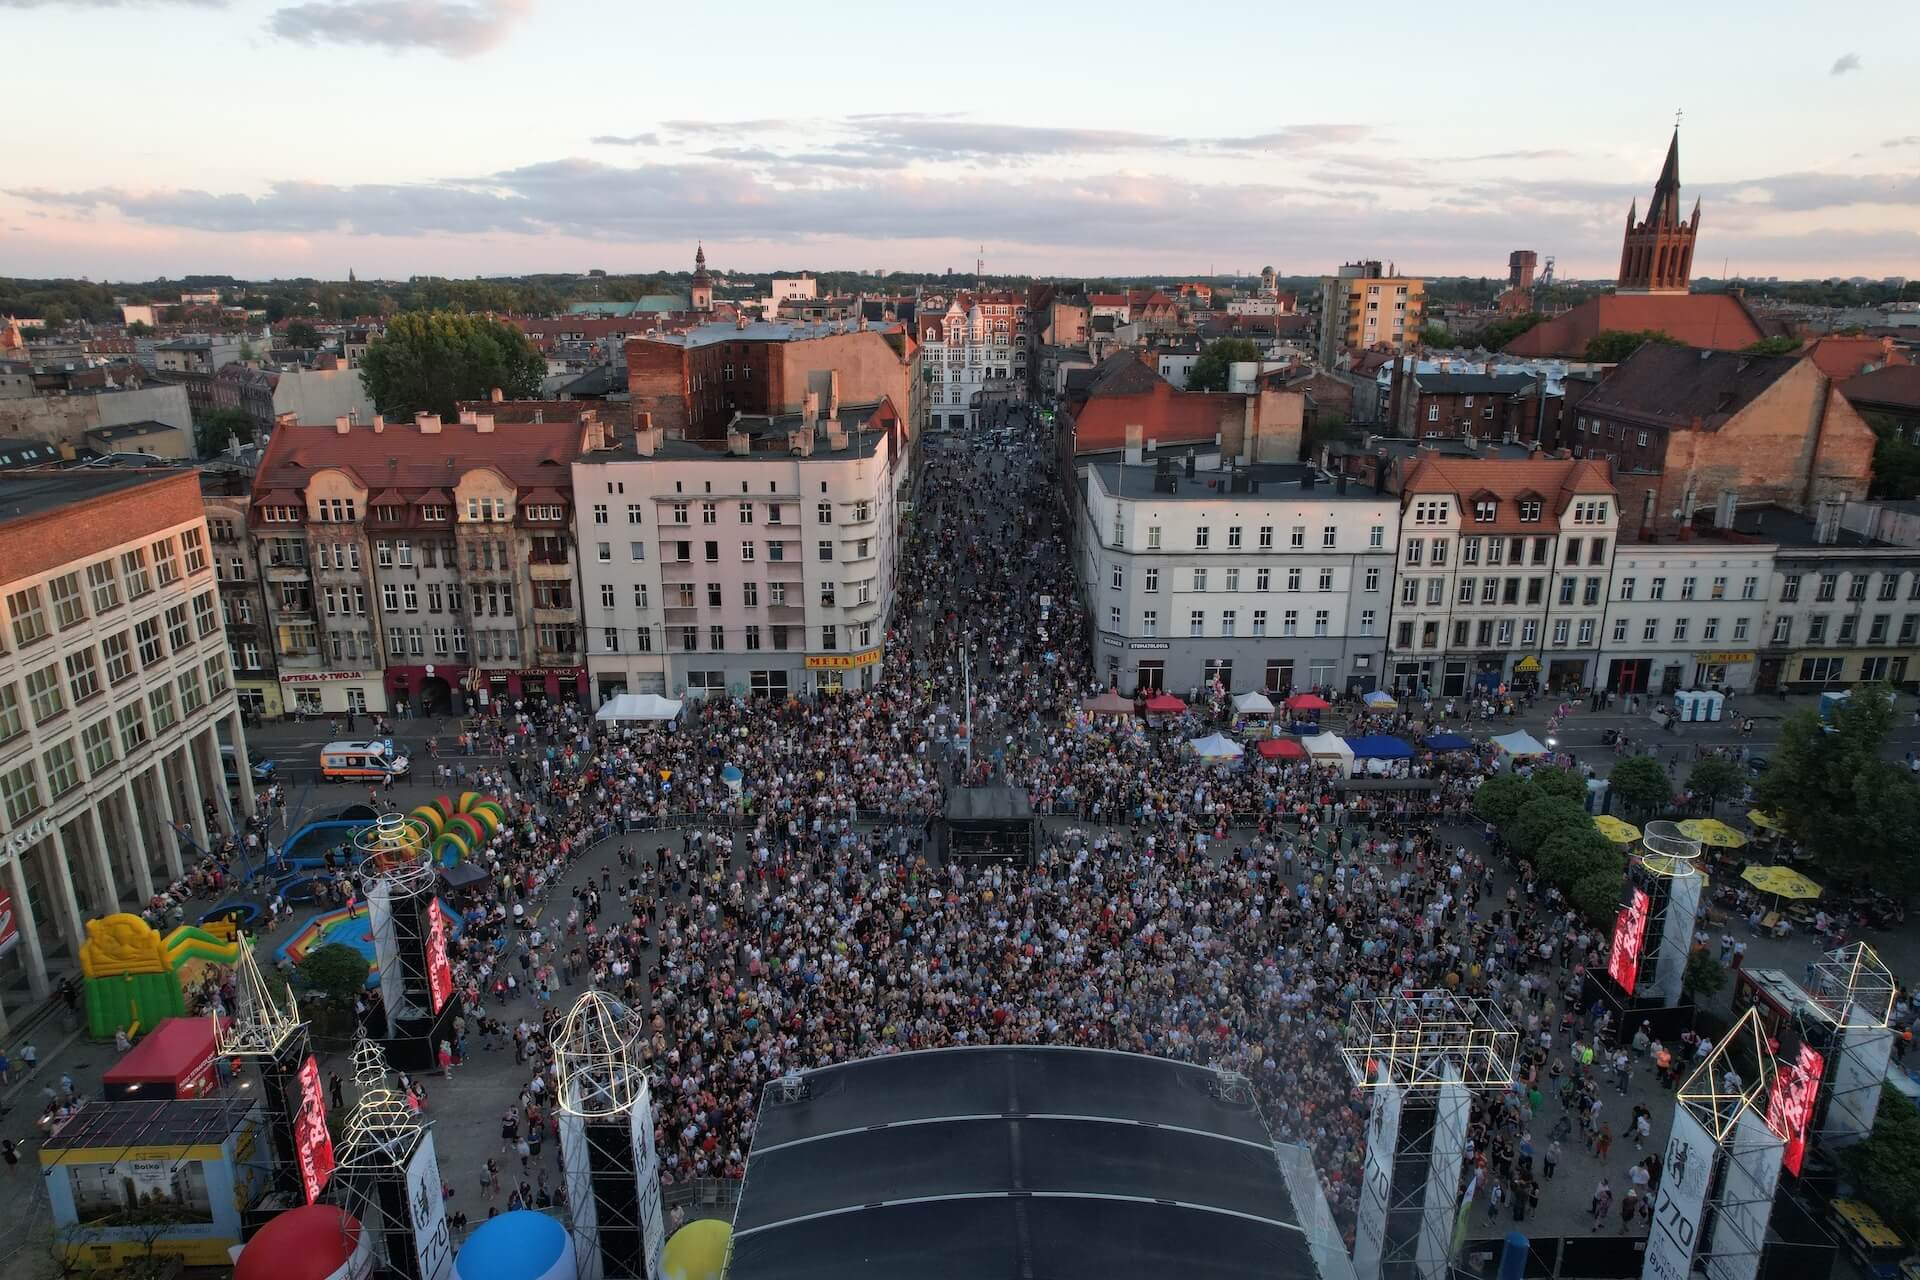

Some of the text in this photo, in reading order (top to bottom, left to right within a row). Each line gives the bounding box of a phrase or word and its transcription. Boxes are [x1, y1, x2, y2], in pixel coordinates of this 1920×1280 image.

[281, 671, 361, 682] APTEKA TWOJA
[809, 657, 849, 665] META
[1610, 929, 1624, 980] BEATA
[430, 963, 443, 1008] BEATA
[302, 1142, 320, 1201] BEATA
[1366, 1146, 1389, 1201] 770
[1658, 1188, 1694, 1247] 770
[420, 1217, 449, 1275] 770
